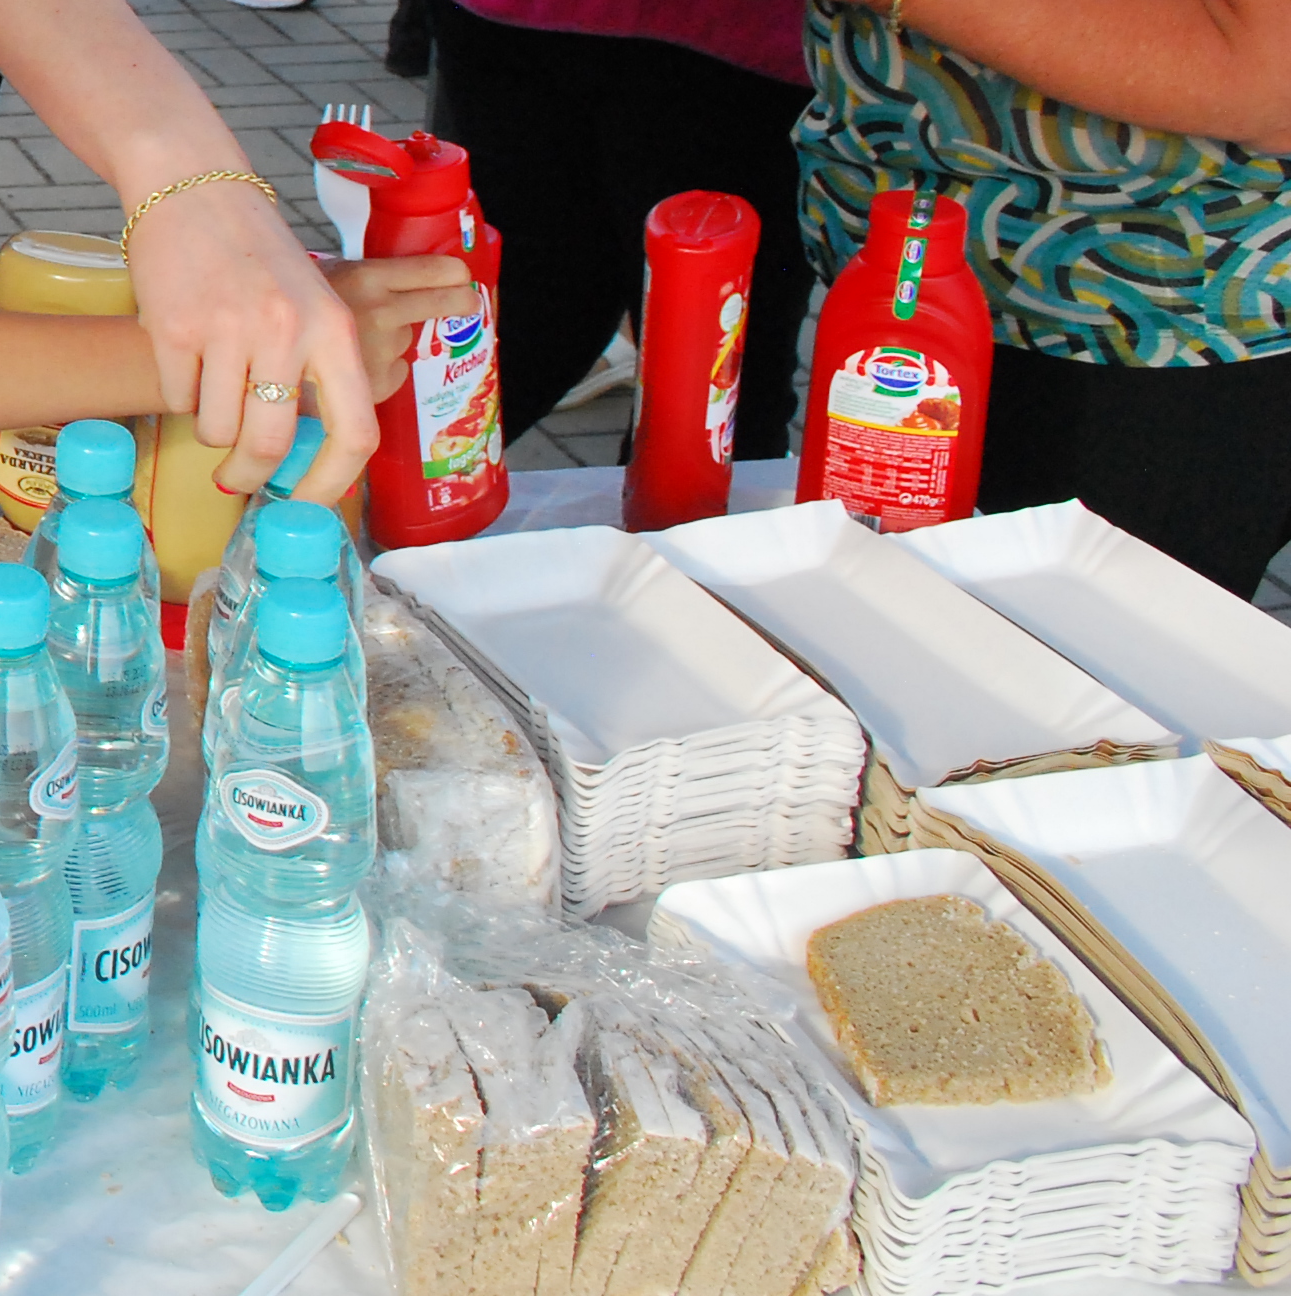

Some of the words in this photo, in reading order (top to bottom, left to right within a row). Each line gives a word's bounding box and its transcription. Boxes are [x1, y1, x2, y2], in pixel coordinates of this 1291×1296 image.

[442, 348, 488, 387] Ketchup
[874, 363, 920, 380] Tortex
[0, 453, 56, 477] ZTARDA
[232, 787, 307, 822] CISOWIANKA
